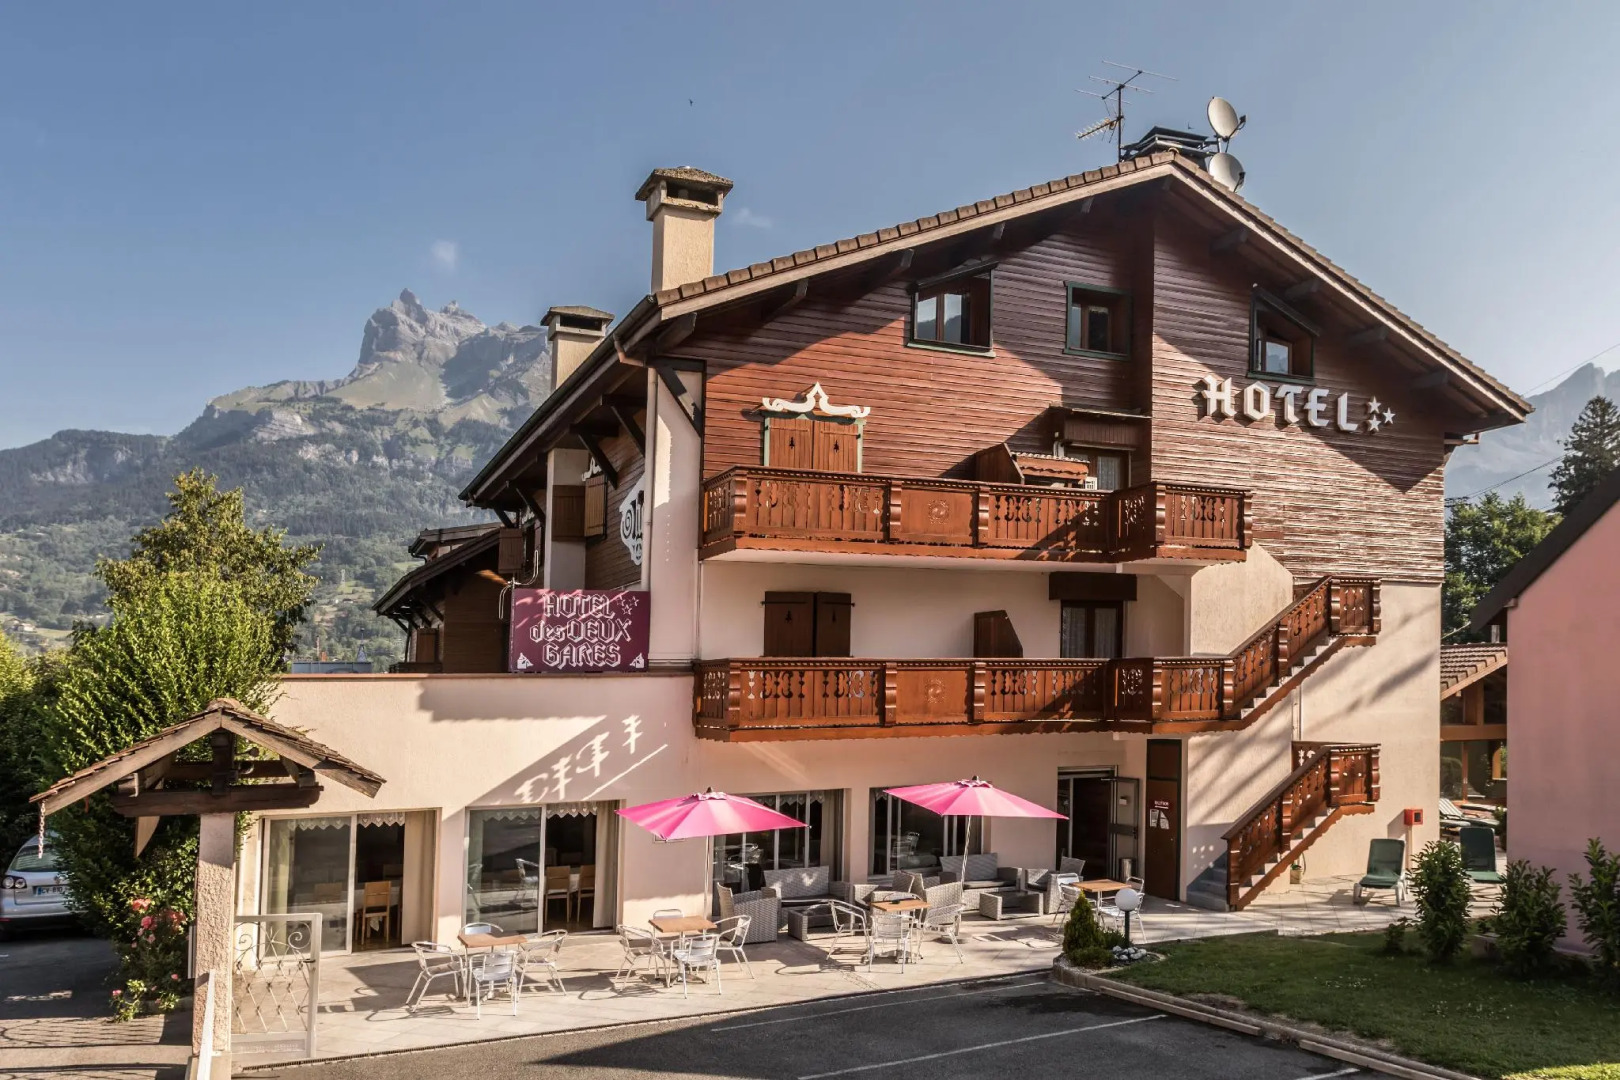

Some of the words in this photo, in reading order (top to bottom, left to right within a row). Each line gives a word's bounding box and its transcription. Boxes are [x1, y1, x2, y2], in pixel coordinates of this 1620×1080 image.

[1201, 374, 1359, 432] HOTEL
[542, 594, 616, 619] HOTEL
[530, 620, 566, 643] des
[566, 618, 632, 643] DEUX
[542, 642, 621, 669] GARES
